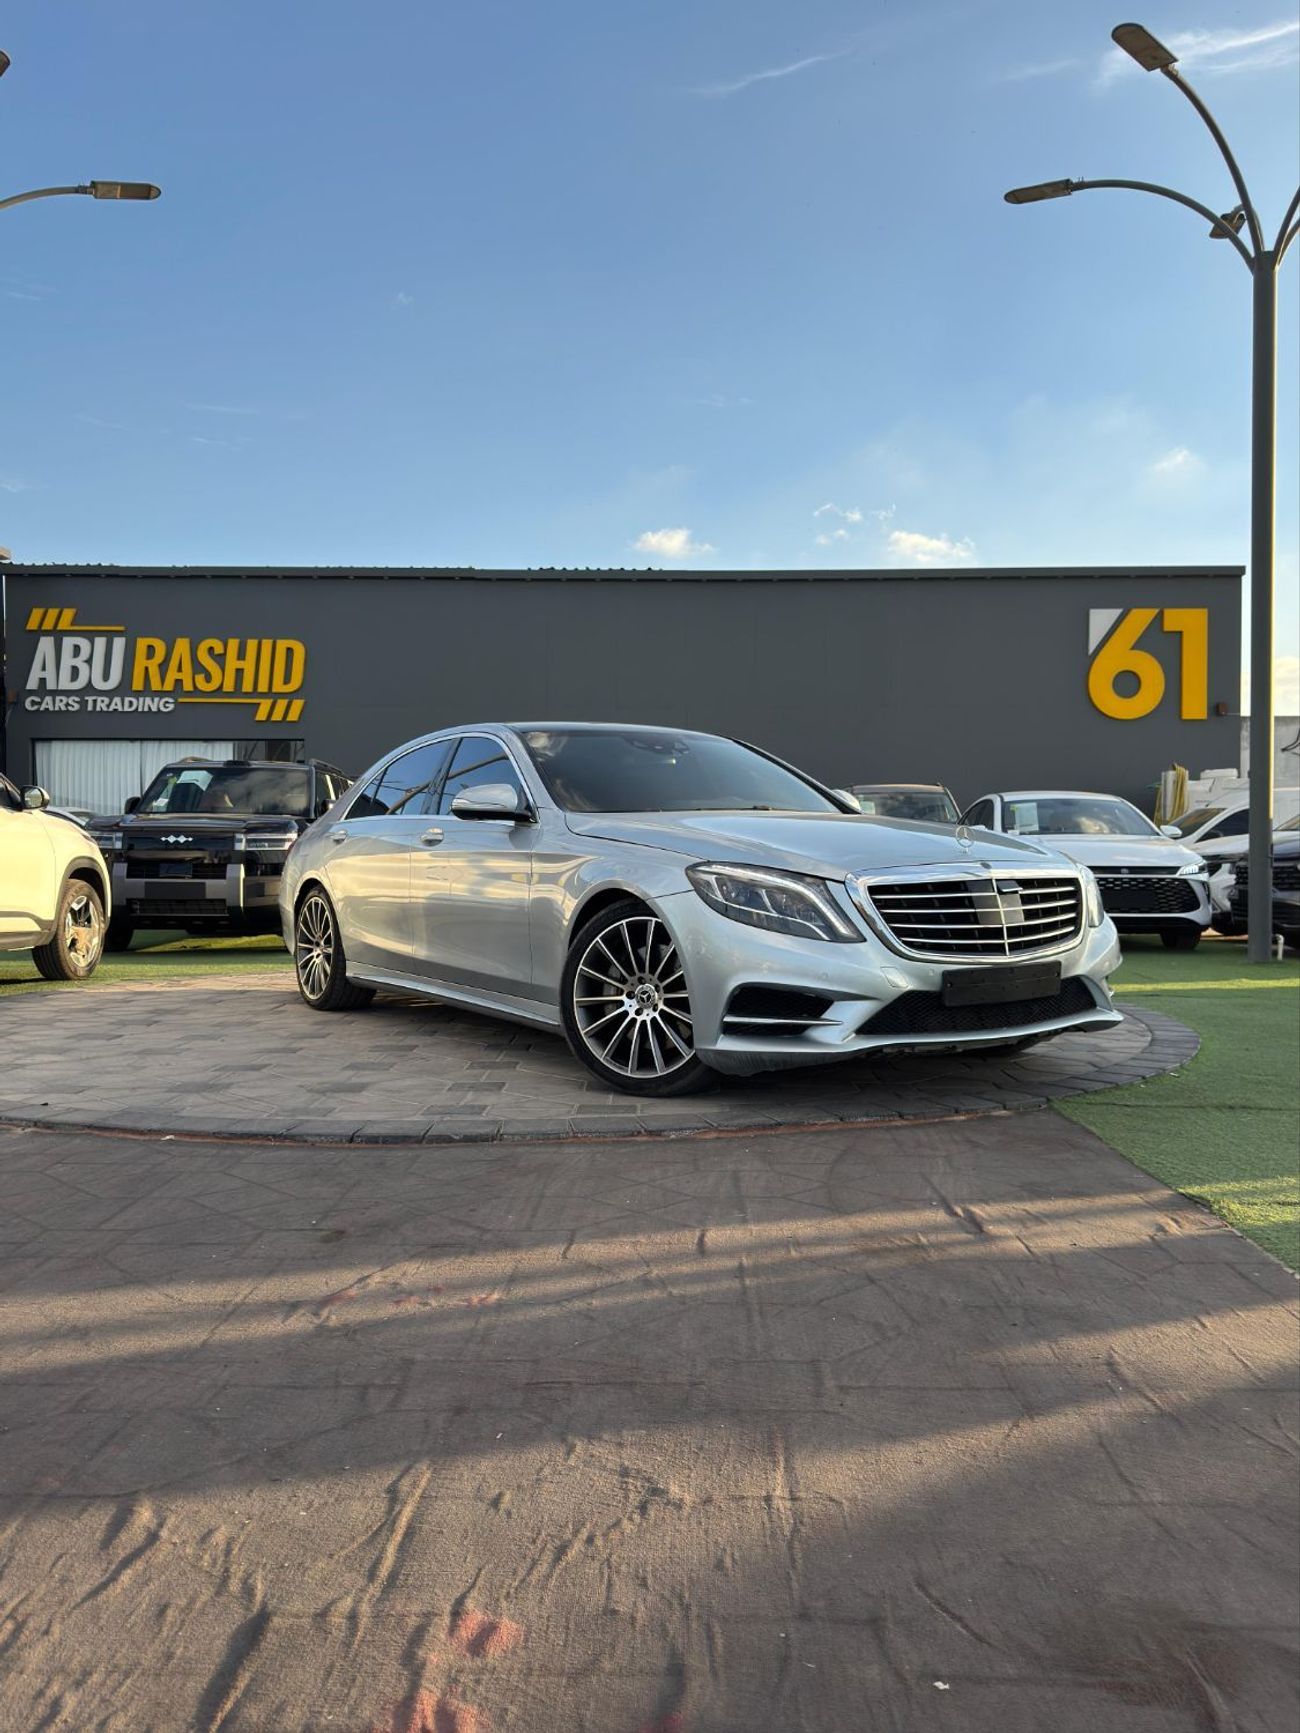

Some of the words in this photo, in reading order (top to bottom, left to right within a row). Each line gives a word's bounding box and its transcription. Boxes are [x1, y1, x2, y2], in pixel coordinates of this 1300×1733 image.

[25, 636, 126, 691] ABU
[131, 637, 306, 693] RASHID
[1088, 608, 1208, 720] 61
[25, 696, 80, 711] CARS
[85, 696, 175, 712] TRADING
